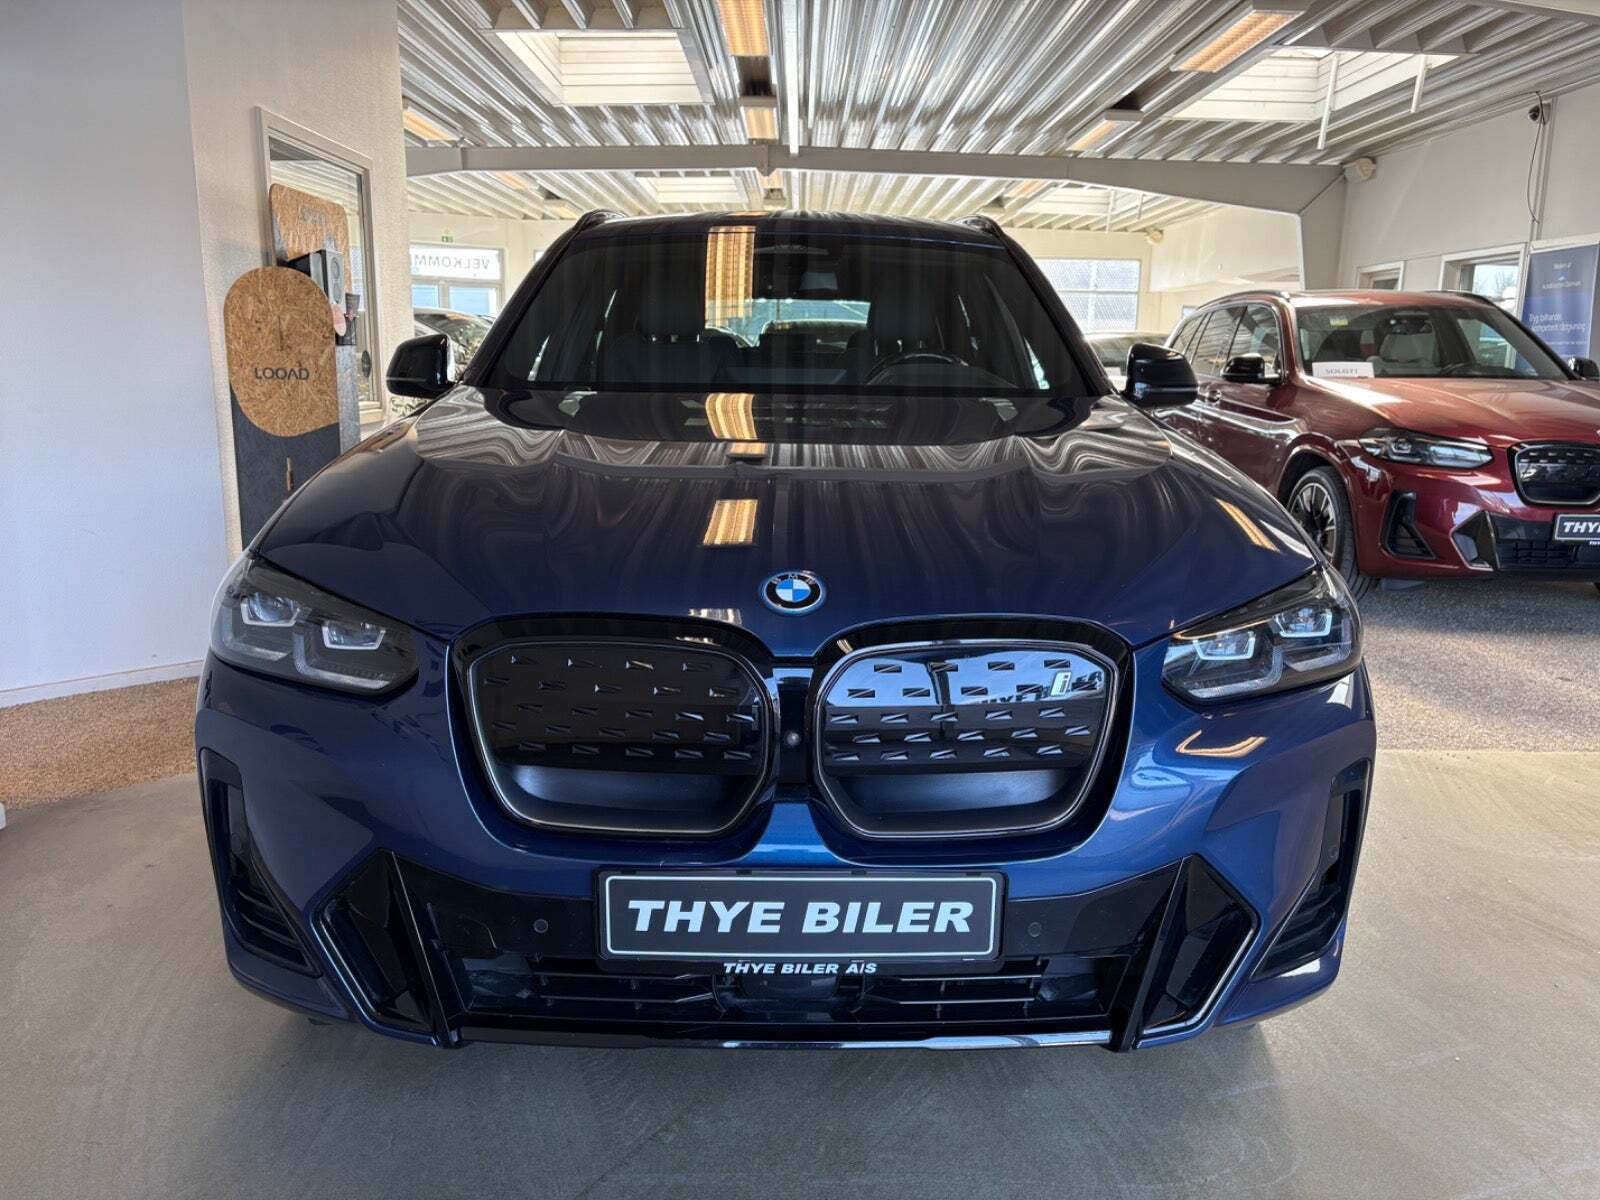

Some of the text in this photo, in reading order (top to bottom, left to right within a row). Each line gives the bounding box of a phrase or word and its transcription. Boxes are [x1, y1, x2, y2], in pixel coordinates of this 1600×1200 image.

[628, 900, 975, 934] THYE BILER
[723, 962, 878, 975] THYE BILER A/S
